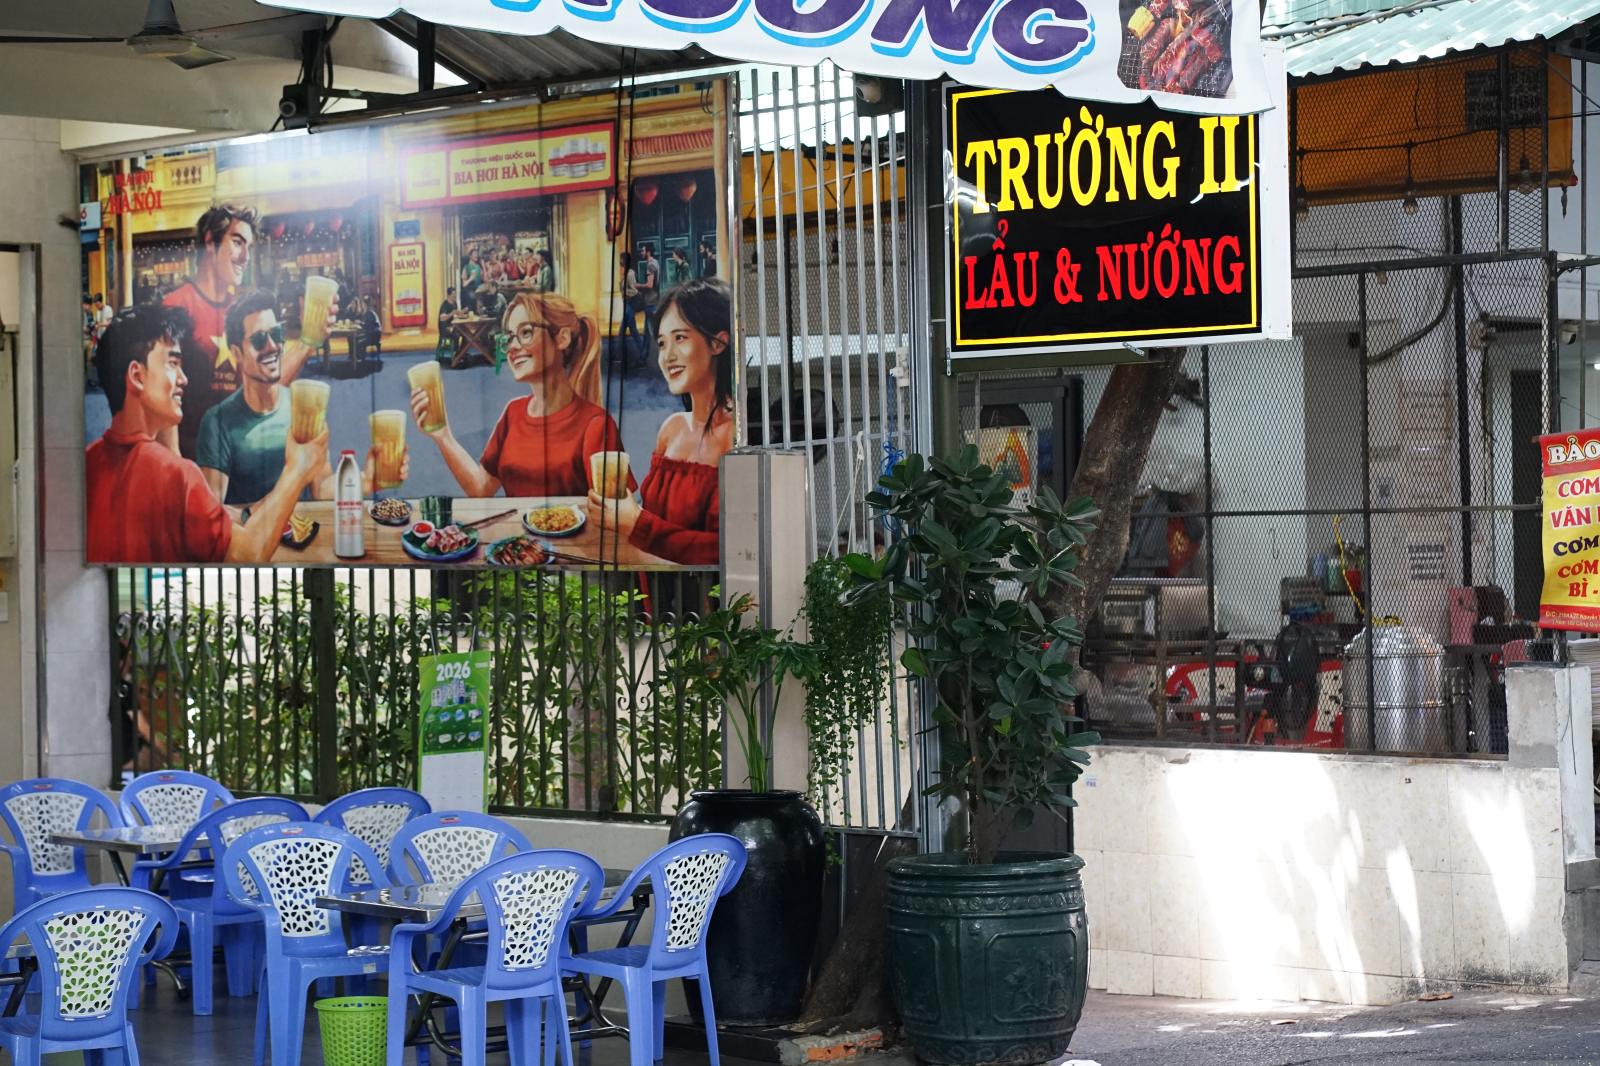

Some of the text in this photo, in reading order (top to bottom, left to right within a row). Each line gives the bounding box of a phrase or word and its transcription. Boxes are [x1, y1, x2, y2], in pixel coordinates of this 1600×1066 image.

[964, 106, 1240, 214] TRƯỜNG II
[454, 171, 473, 185] BIA
[476, 167, 498, 182] HƠI
[502, 162, 519, 179] HÀ
[521, 160, 544, 179] NỘI
[133, 186, 162, 215] NỘI
[965, 219, 1244, 309] LẨU & NƯỚNG
[1547, 435, 1600, 465] BẢO
[1558, 477, 1600, 498] CƠM
[1551, 506, 1591, 528] VĂN
[1553, 535, 1600, 556] CƠM
[1558, 559, 1599, 578] CƠM
[1568, 578, 1588, 597] BÌ
[436, 661, 471, 682] 2026
